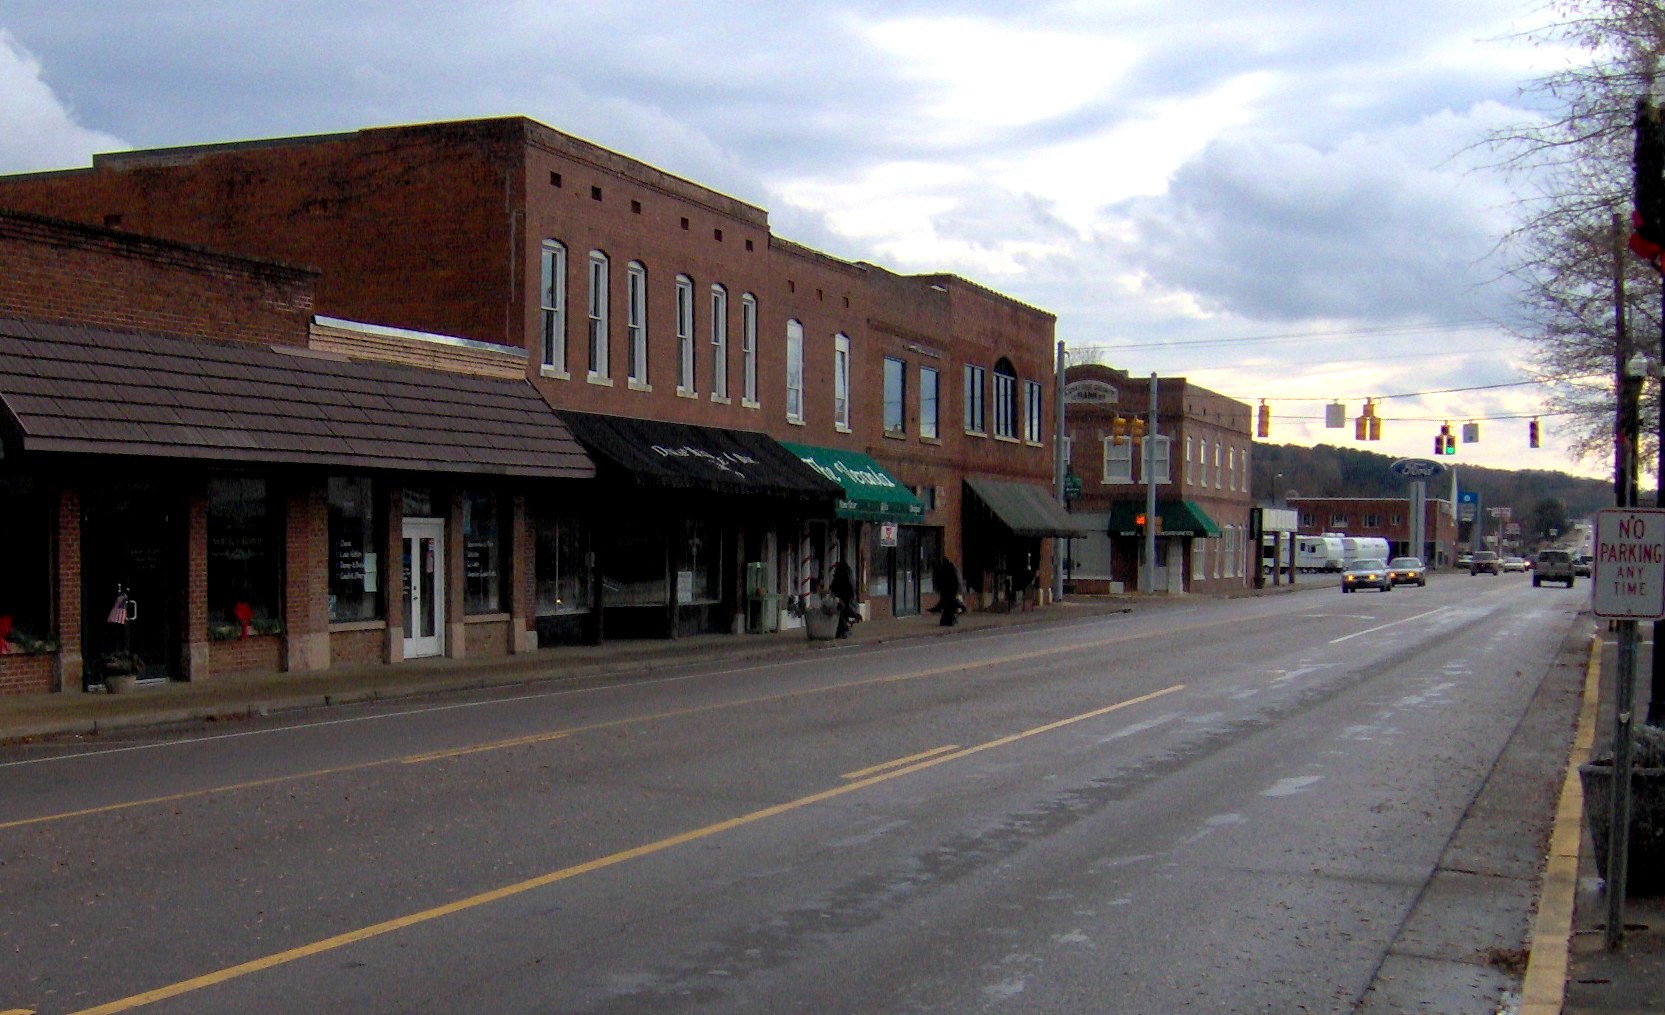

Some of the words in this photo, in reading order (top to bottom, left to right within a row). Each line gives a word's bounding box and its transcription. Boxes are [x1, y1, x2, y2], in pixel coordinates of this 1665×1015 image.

[1619, 519, 1645, 539] NO
[1600, 543, 1662, 564] PARKING
[1617, 567, 1645, 579] ANY
[1614, 581, 1647, 596] TIME
